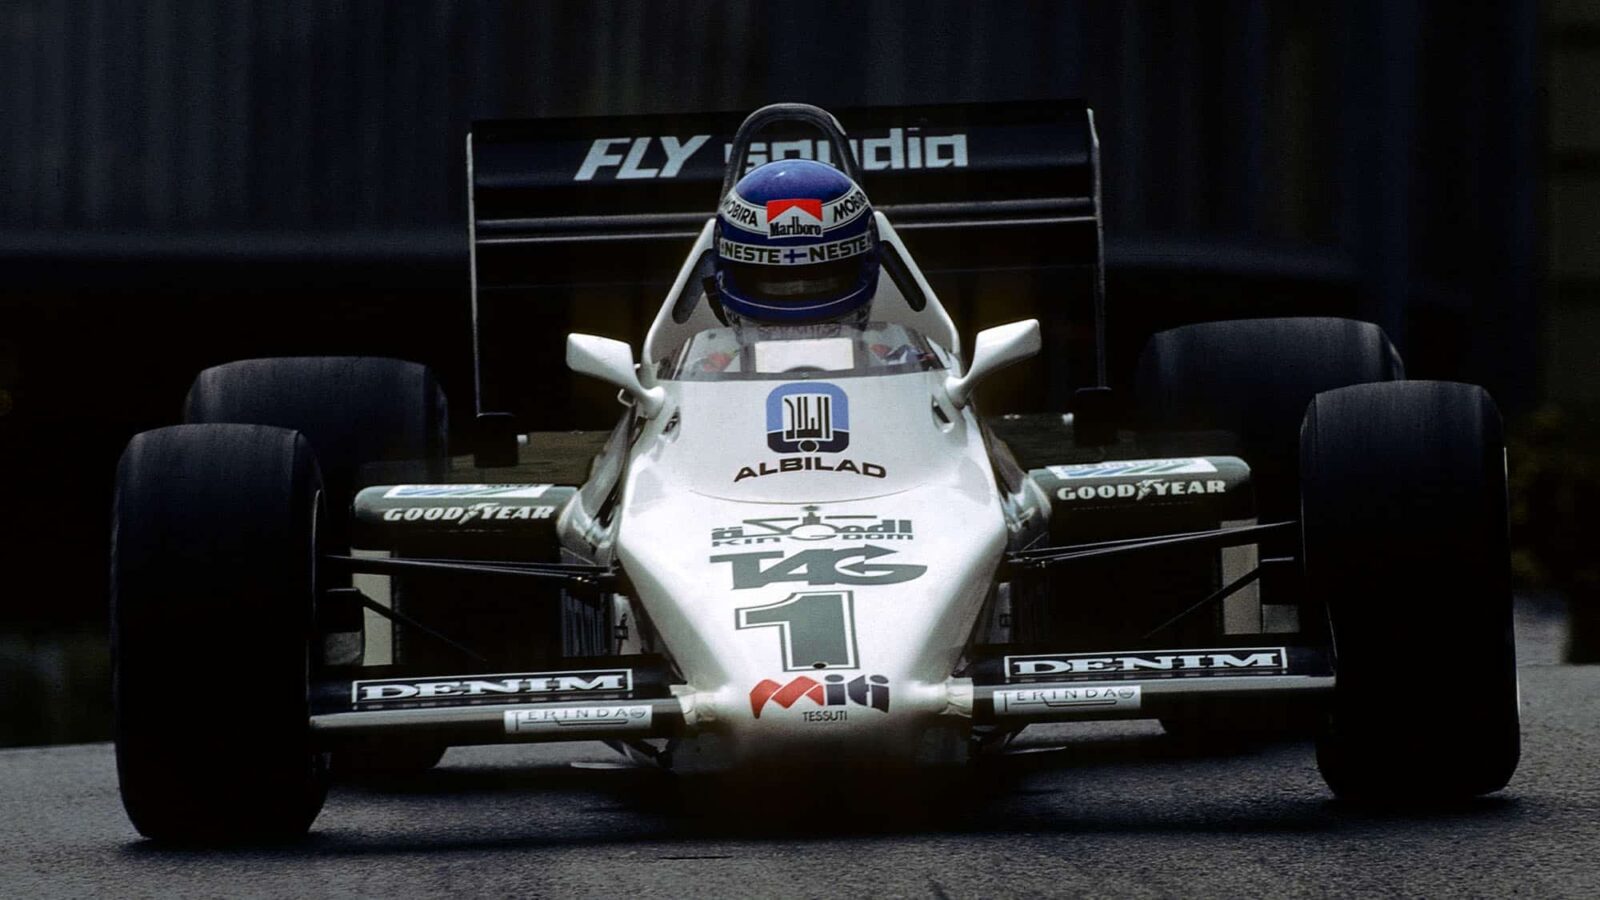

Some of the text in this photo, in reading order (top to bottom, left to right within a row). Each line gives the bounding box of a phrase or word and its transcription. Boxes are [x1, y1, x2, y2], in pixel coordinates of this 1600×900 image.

[573, 135, 712, 181] FLY
[720, 199, 758, 227] OBIRA
[770, 216, 822, 236] Marlboro
[725, 237, 867, 263] NESTE NESTE
[734, 456, 887, 483] ALBILAD
[709, 544, 928, 590] TAG
[734, 590, 861, 673] 1
[1012, 653, 1280, 675] DENIM
[360, 674, 626, 700] DENIM
[802, 710, 849, 722] TESSUTI
